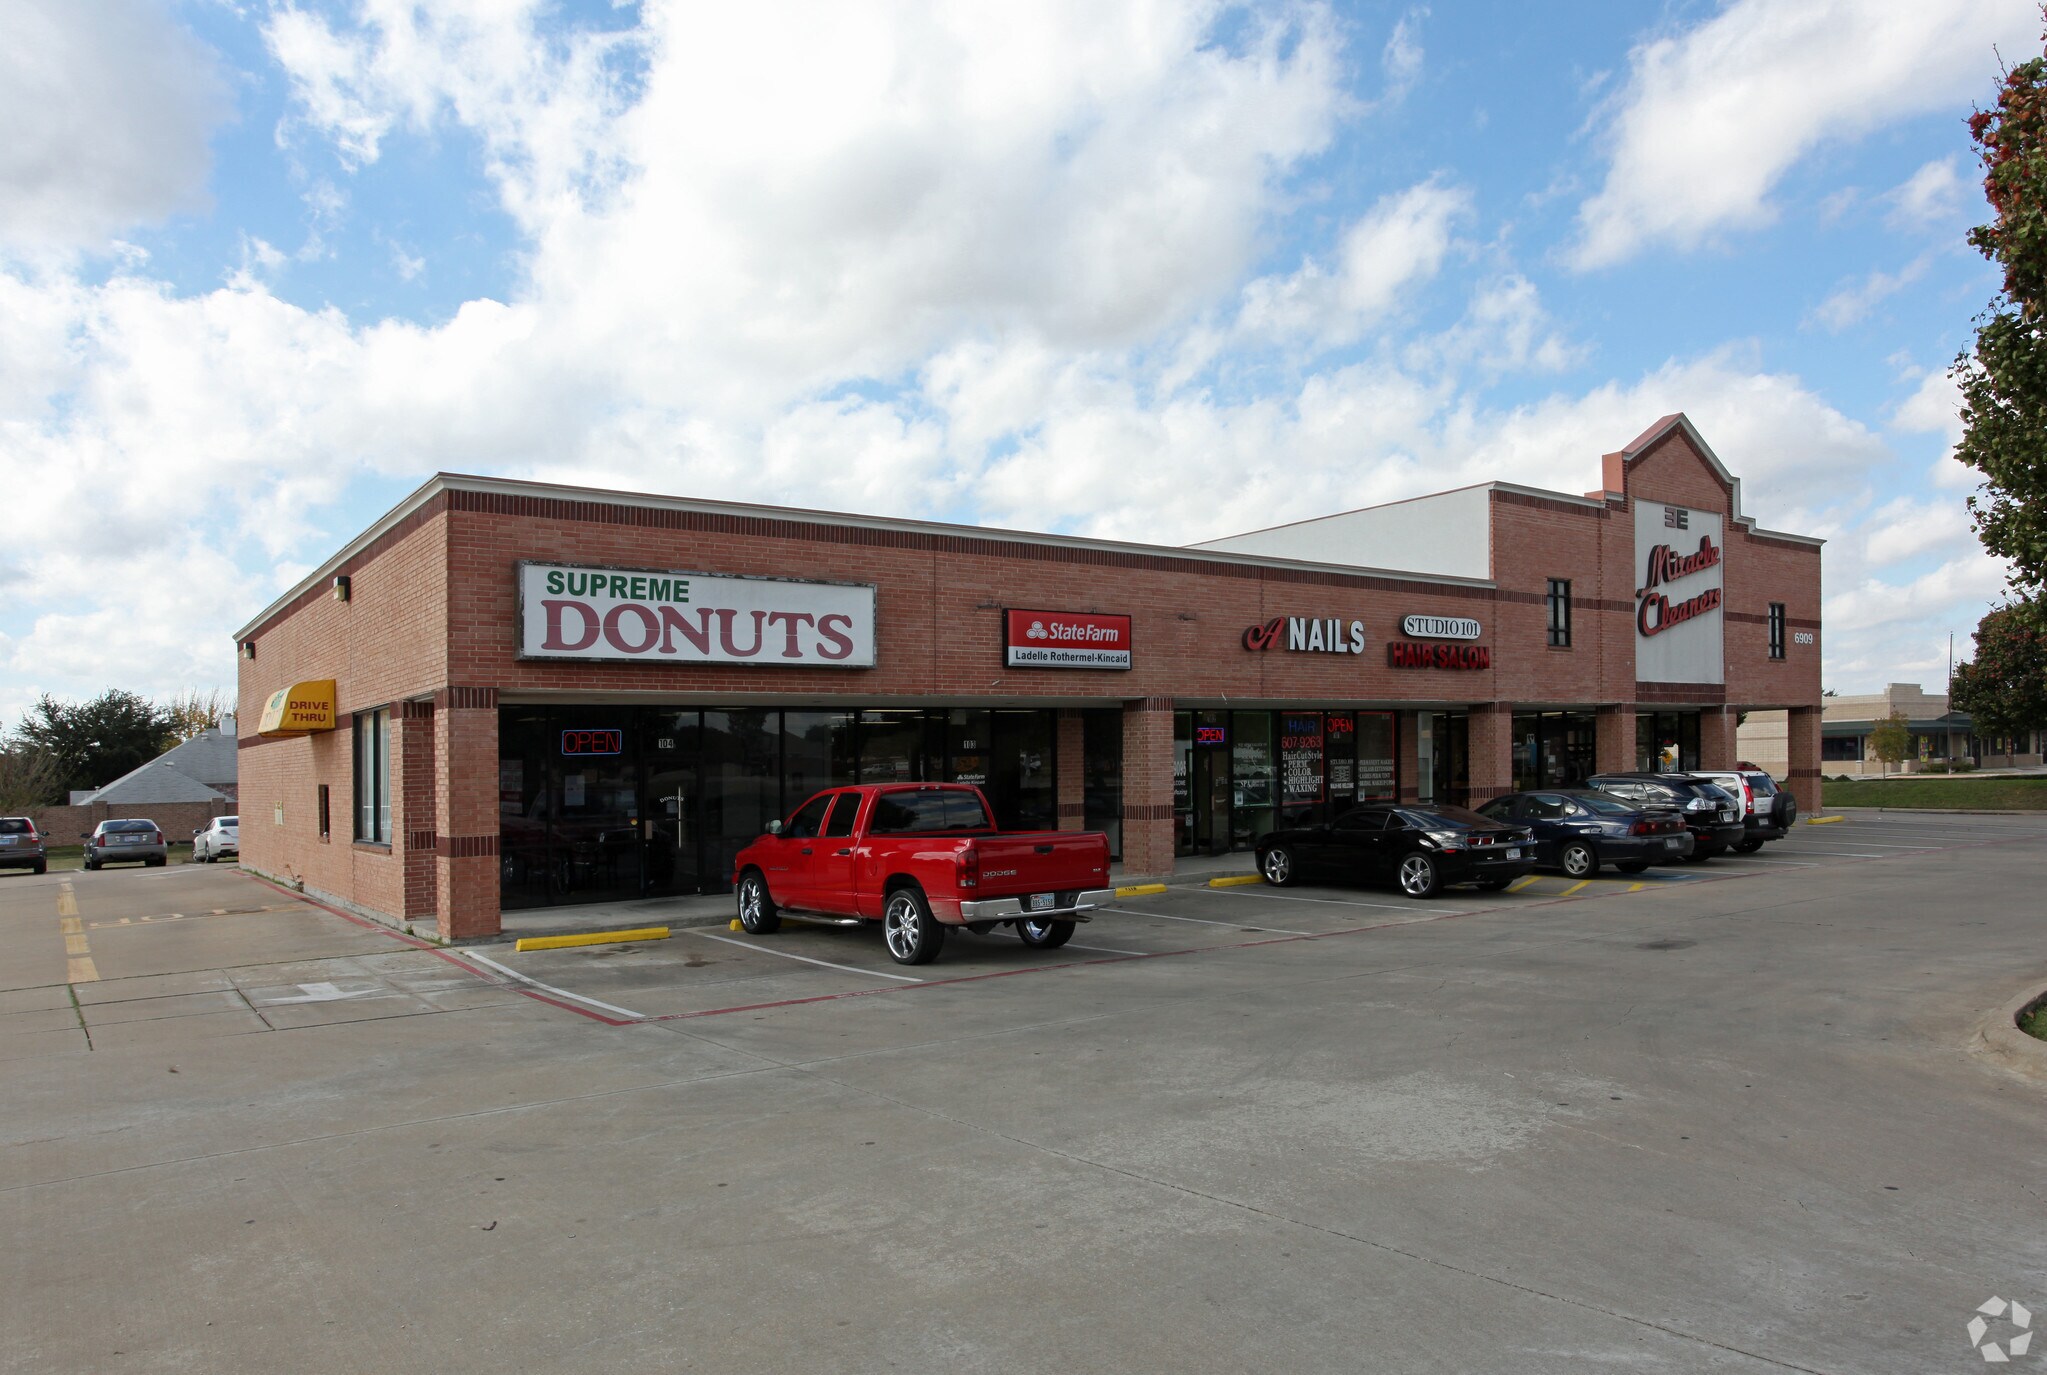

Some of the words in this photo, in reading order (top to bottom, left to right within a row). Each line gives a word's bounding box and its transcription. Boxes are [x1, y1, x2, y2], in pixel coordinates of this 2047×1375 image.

[1636, 535, 1721, 598] Miracle
[546, 570, 690, 603] SUPREME
[1637, 588, 1721, 637] Cleaners
[540, 599, 854, 661] DONUTS
[1406, 617, 1458, 636] STUDIO
[1460, 620, 1479, 637] 101
[1244, 616, 1286, 650] A
[1287, 616, 1365, 655] NAILS
[1793, 632, 1813, 644] 6909
[1015, 650, 1048, 661] Ladelle
[1050, 651, 1128, 663] Rothermel-Kincaid
[1391, 642, 1434, 668] HAIR
[1437, 644, 1490, 669] SALON
[289, 701, 329, 711] DRIVE
[291, 713, 327, 722] THRU
[1288, 719, 1316, 733] HAIR
[1327, 718, 1353, 733] OPEN
[563, 731, 620, 753] OPEN
[1197, 729, 1223, 742] OPEN
[658, 738, 674, 749] 104
[1281, 736, 1322, 749] 607-9263
[1287, 767, 1312, 777] COLOR
[1288, 775, 1324, 785] HIGHLIGHT
[1288, 783, 1318, 793] WAXING
[659, 795, 685, 804] DONUTS
[982, 869, 1017, 877] DODGE
